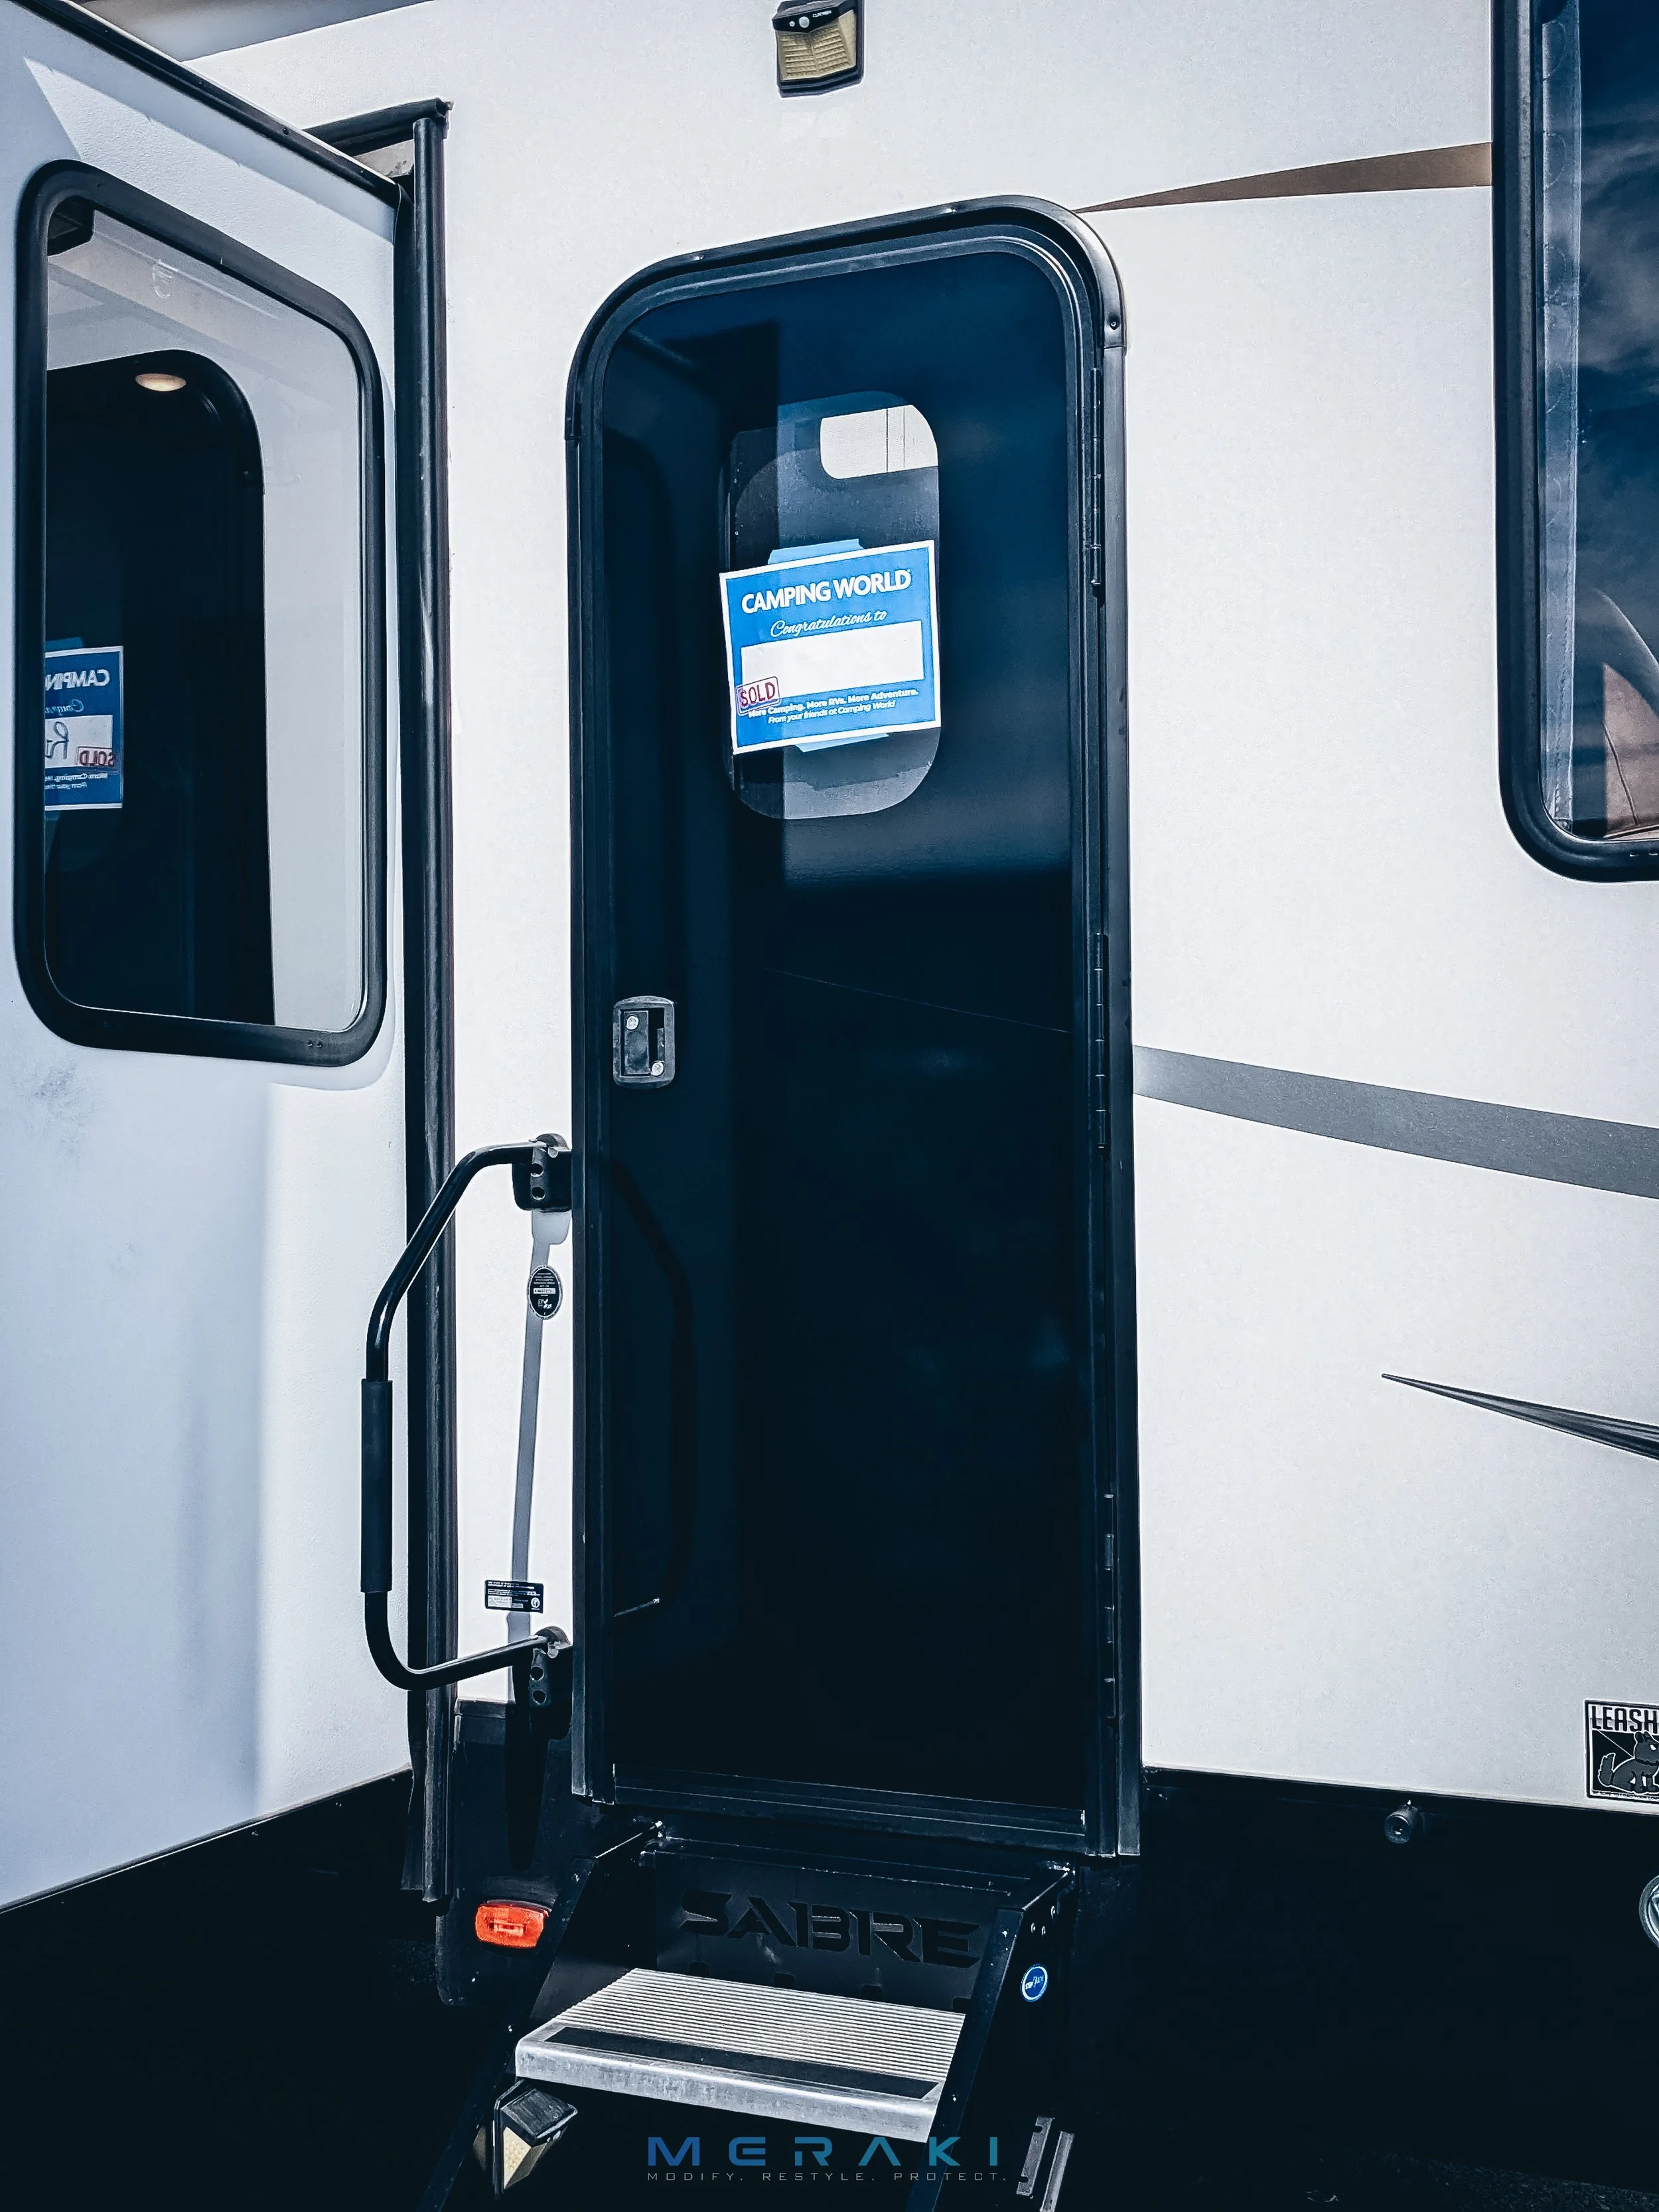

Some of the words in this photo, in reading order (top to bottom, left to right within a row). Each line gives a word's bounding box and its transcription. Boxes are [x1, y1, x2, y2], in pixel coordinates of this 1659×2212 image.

[741, 581, 831, 614] CAMPING
[832, 569, 912, 599] WORLD
[770, 611, 873, 637] Congratulations
[873, 610, 888, 621] to
[740, 682, 776, 707] SOLD
[748, 709, 767, 718] More
[767, 703, 806, 715] Camping.
[806, 701, 828, 709] More
[848, 695, 869, 703] More
[871, 689, 919, 700] Adventure.
[786, 713, 804, 723] your
[837, 703, 871, 714] Camping
[873, 700, 896, 709] World
[1591, 1706, 1658, 1734] LEASH
[678, 1889, 982, 1968] SABRE
